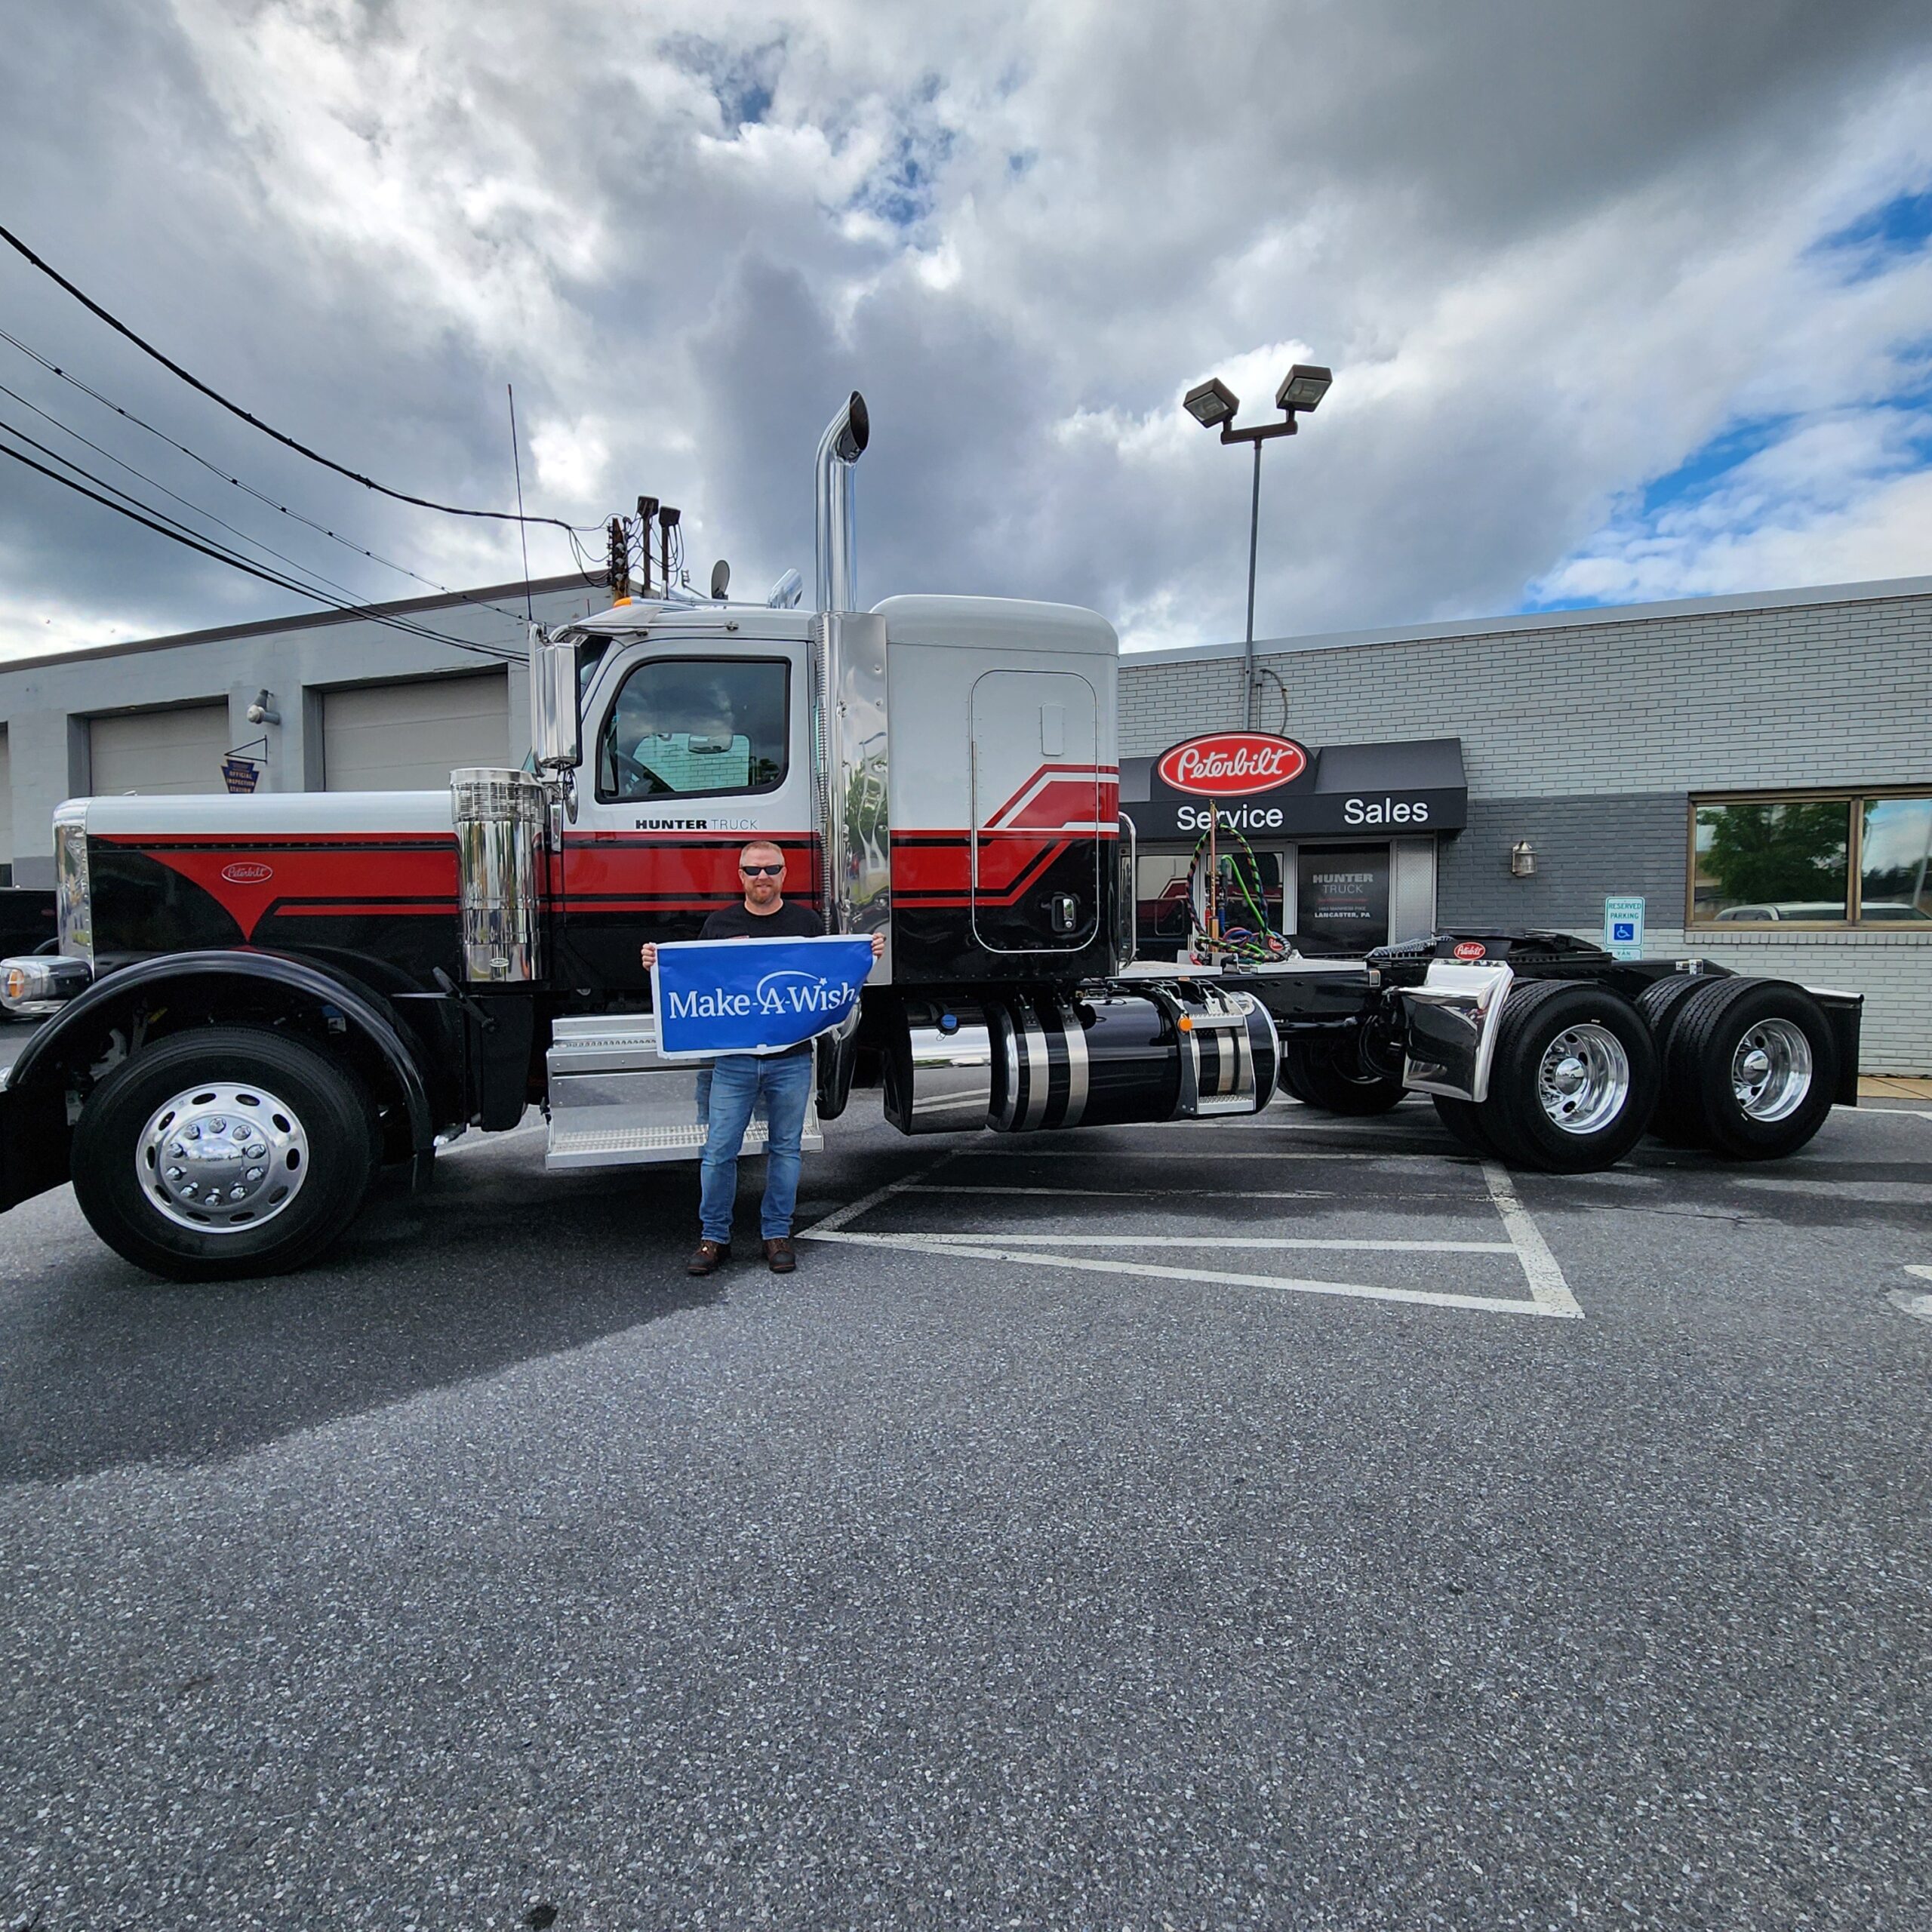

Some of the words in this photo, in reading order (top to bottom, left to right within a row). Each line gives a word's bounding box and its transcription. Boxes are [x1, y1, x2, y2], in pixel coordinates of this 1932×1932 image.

[1177, 747, 1294, 782] Peterbilt
[229, 770, 253, 780] OFFICIAL
[226, 778, 255, 787] INSPECTION
[1344, 798, 1429, 824] Sales
[1177, 804, 1283, 830] Service
[635, 820, 707, 829] HUNTER
[711, 820, 758, 830] TRUCK
[228, 866, 268, 877] Peterbilt
[1312, 873, 1374, 883] HUNTER
[1323, 884, 1364, 894] TRUCK
[667, 981, 857, 1019] Make-A-Wish
